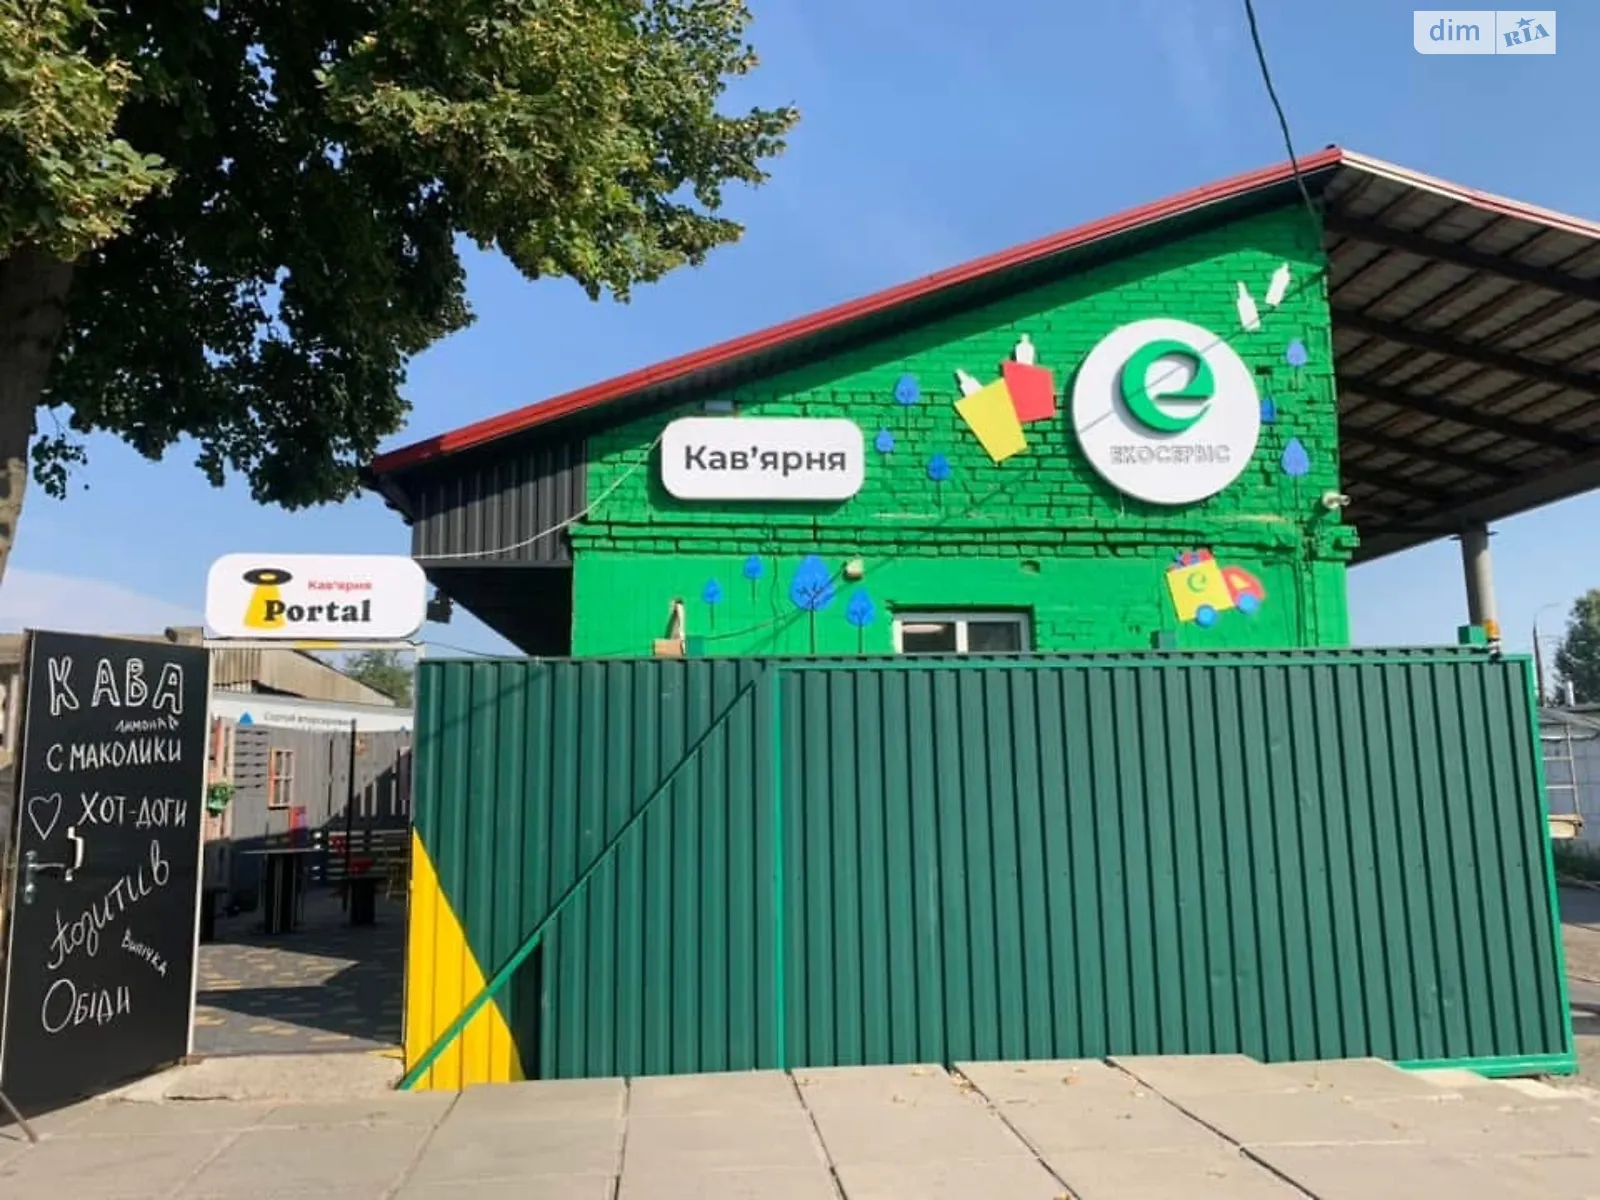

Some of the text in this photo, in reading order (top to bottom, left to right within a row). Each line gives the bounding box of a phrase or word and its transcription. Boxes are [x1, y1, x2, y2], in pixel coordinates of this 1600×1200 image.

[1109, 443, 1231, 465] ЕКОСЕРВІС
[264, 599, 371, 622] Portal
[48, 655, 184, 716] КАВА
[77, 791, 188, 829] ХОТ-ДОГИ
